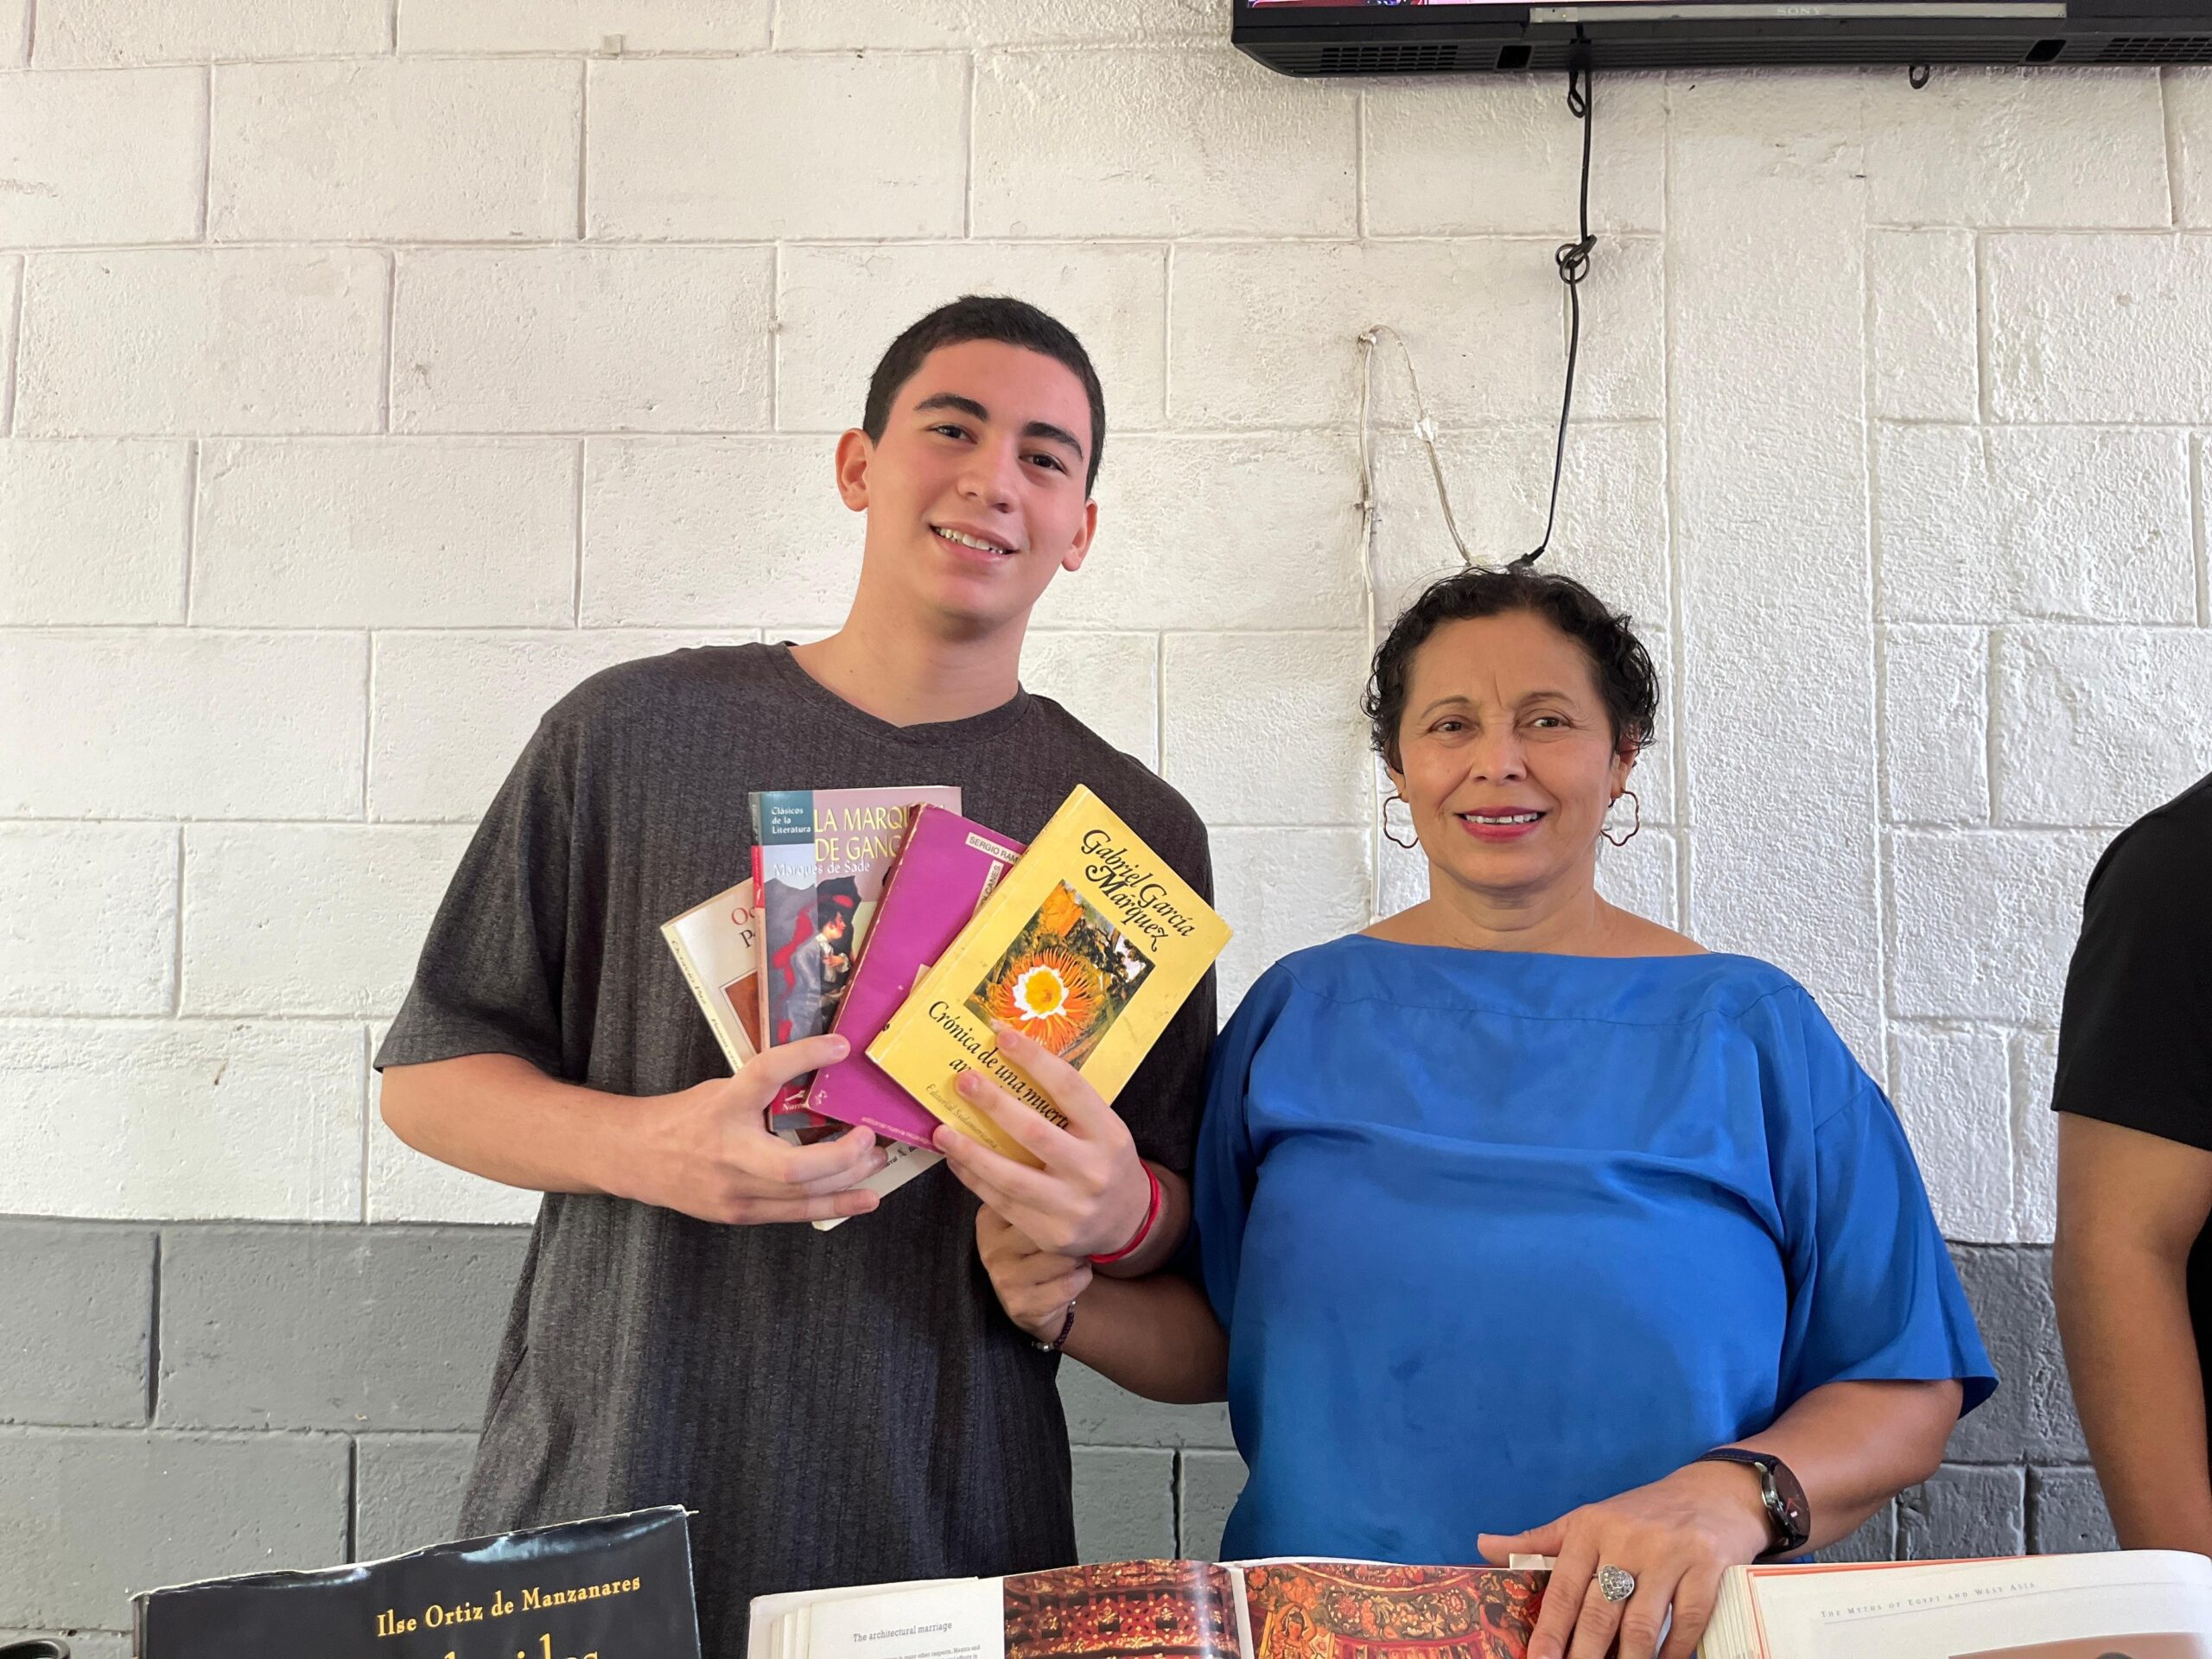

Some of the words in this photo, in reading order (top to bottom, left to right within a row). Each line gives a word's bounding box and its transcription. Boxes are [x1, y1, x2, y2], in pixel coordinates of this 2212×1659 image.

[1777, 6, 1821, 16] SONY
[771, 806, 804, 816] Clásicos
[772, 817, 782, 825] de
[784, 816, 791, 825] la
[813, 808, 838, 833] LA
[772, 825, 811, 835] Literatura
[814, 837, 841, 862] DE
[969, 836, 1000, 855] SERGIO
[827, 861, 841, 874] de
[843, 859, 871, 874] Sade
[1080, 829, 1150, 889] Gabriel
[1137, 882, 1196, 938] García
[1084, 864, 1168, 952] Márquez
[928, 1000, 981, 1055] Crónica
[976, 1046, 999, 1069] de
[995, 1065, 1027, 1094] una
[376, 1609, 417, 1637] Ilse
[424, 1601, 484, 1629] Ortiz
[490, 1590, 515, 1618] de
[520, 1575, 641, 1612] Manzanares
[852, 1632, 868, 1643] The
[868, 1625, 917, 1641] architectural
[918, 1622, 953, 1634] marriage
